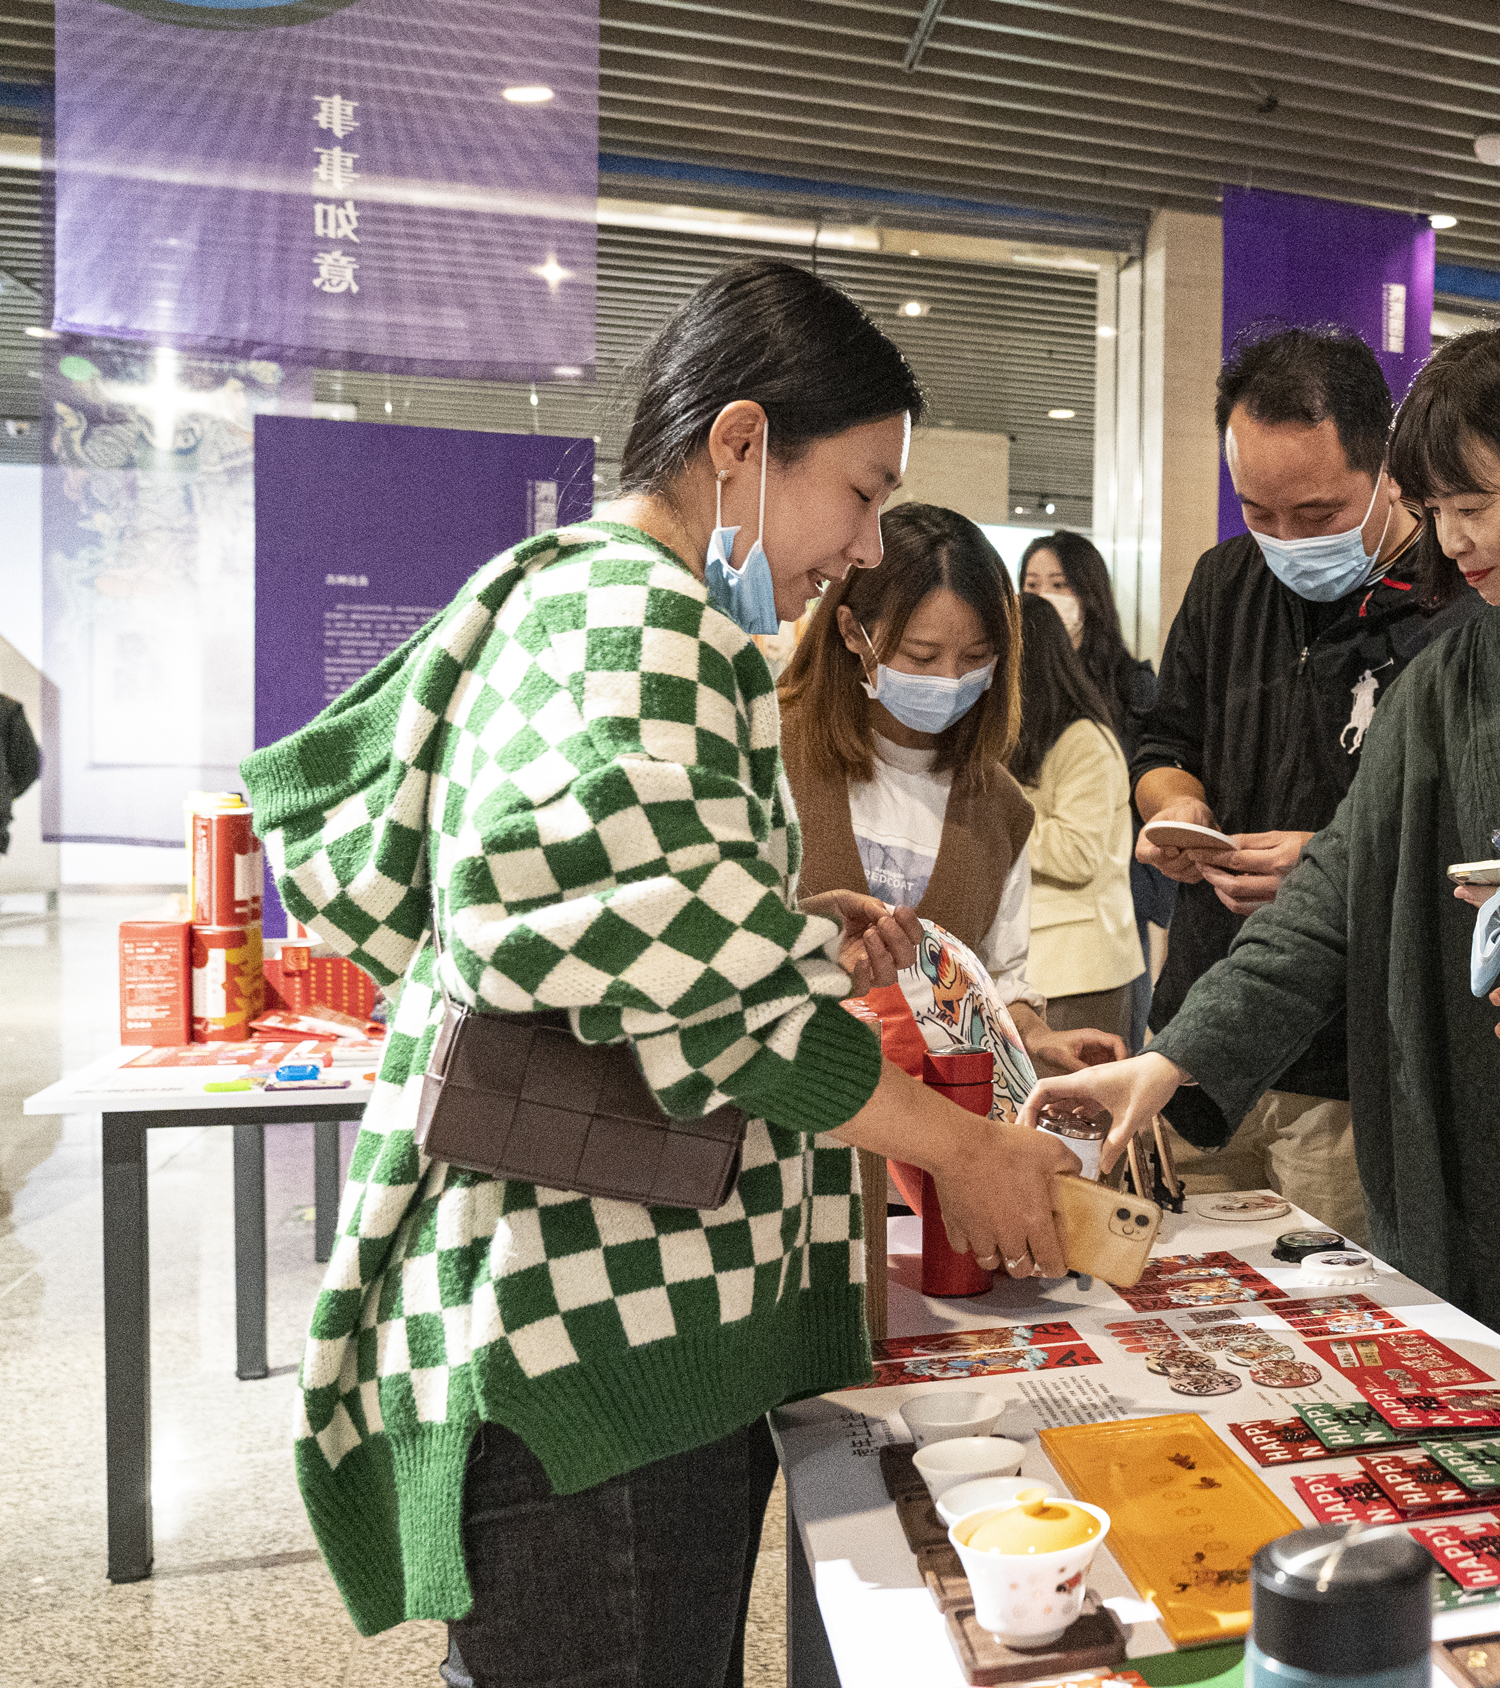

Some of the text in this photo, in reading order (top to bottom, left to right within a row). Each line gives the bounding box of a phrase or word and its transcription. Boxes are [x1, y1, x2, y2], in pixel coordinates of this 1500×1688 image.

[1299, 1402, 1354, 1445] HAPPY
[1369, 1387, 1422, 1424] HAPPY
[1240, 1420, 1292, 1462] HAPPY
[1427, 1441, 1495, 1484] HAPPY
[1369, 1456, 1431, 1504] HAPPY
[1418, 1526, 1499, 1585] HAPPY
